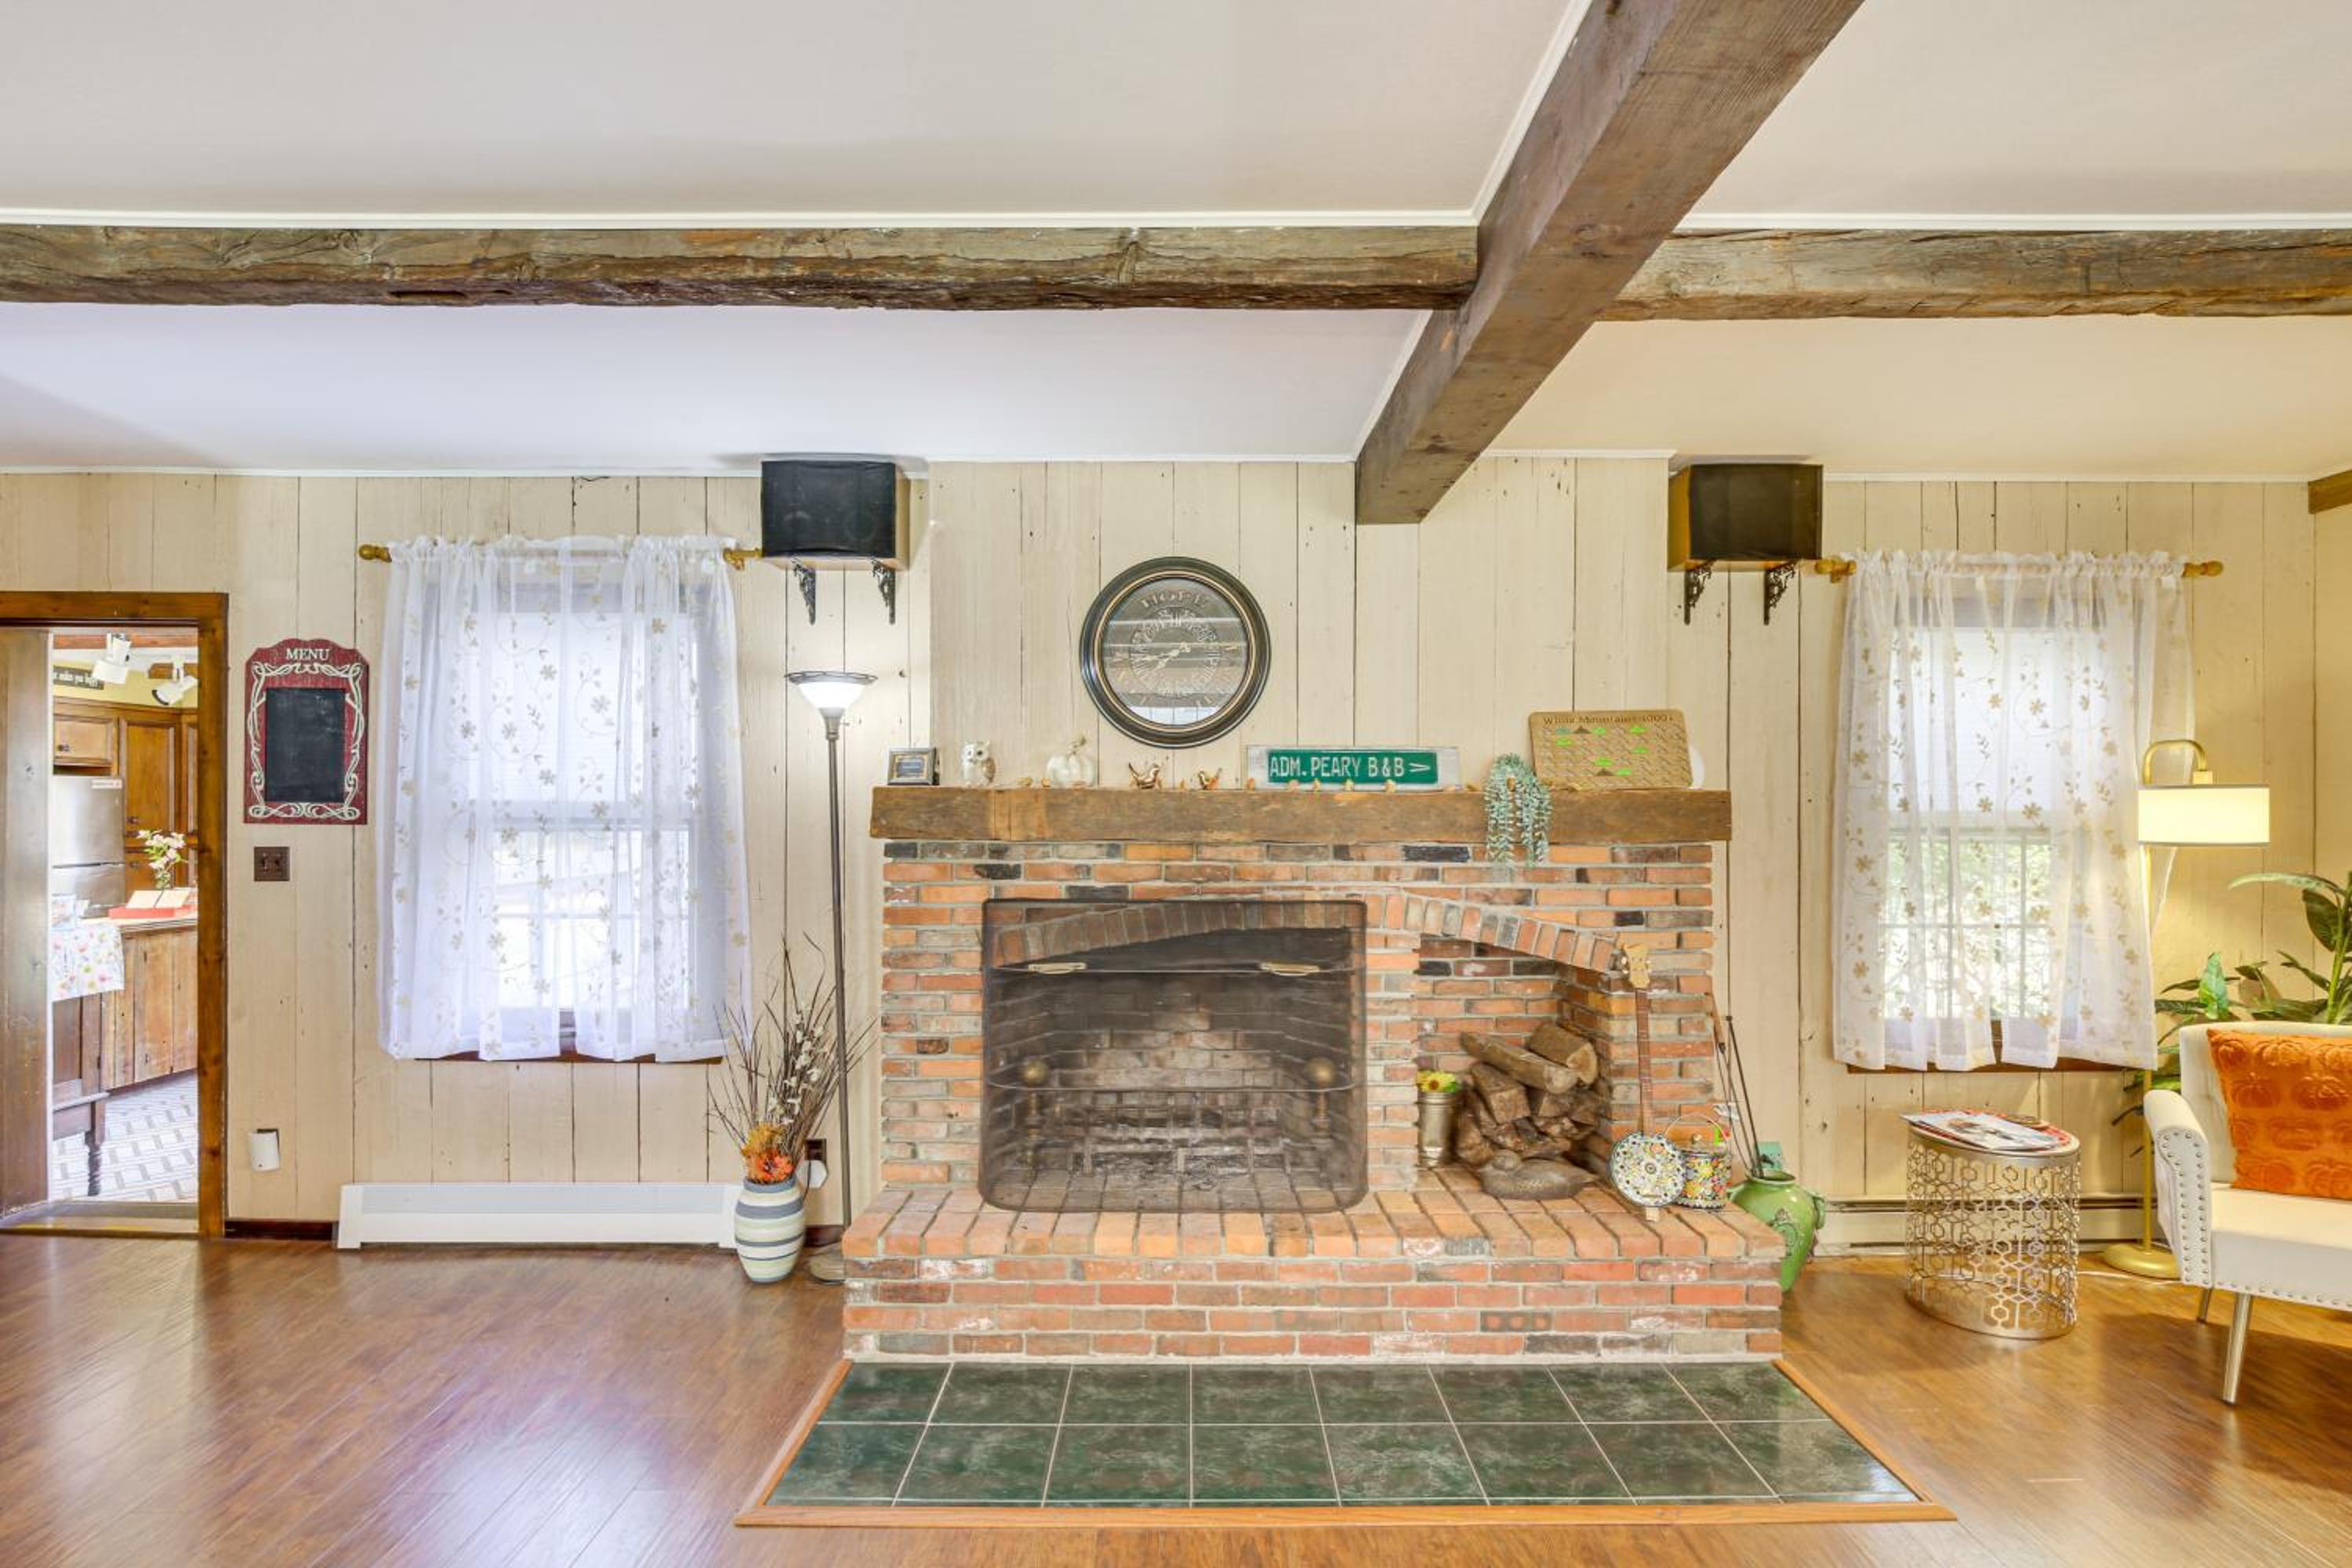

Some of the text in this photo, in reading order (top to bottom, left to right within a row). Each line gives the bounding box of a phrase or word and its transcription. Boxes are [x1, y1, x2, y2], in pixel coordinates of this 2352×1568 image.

[286, 648, 330, 661] MENU
[1269, 756, 1307, 778] ADM.
[1310, 756, 1362, 778] PEARY
